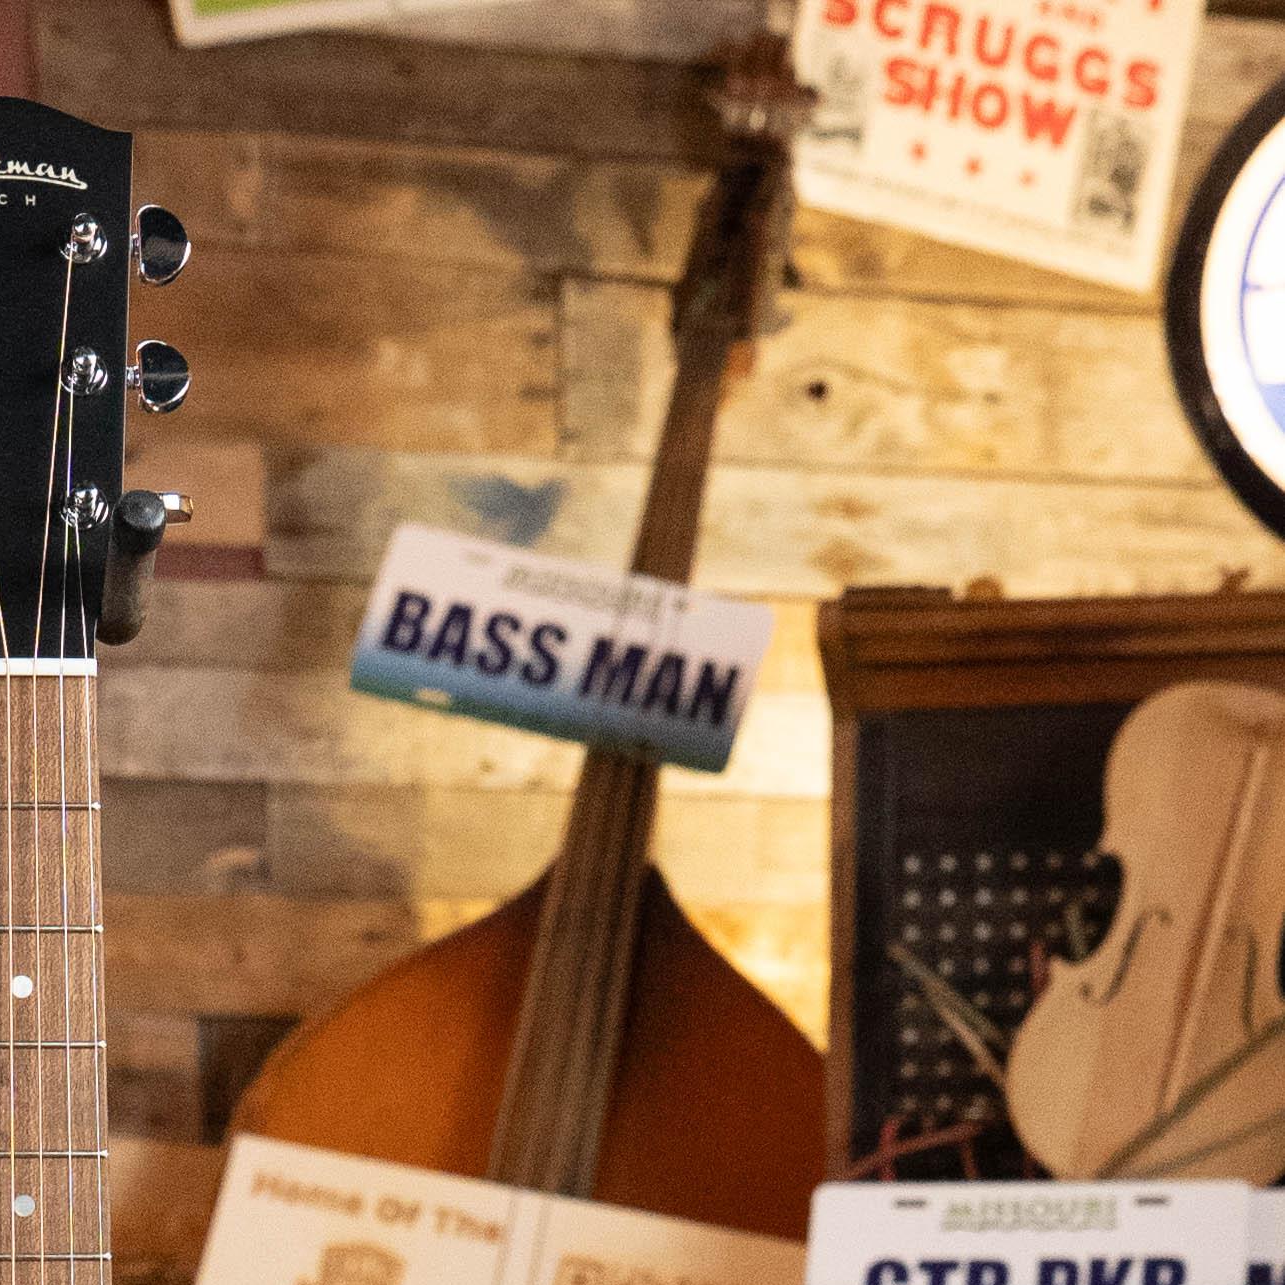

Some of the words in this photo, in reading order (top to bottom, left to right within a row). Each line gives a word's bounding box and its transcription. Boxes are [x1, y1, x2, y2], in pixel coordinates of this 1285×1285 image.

[884, 56, 1078, 149] SHOW
[382, 589, 569, 688] BASS
[578, 636, 741, 728] MAN
